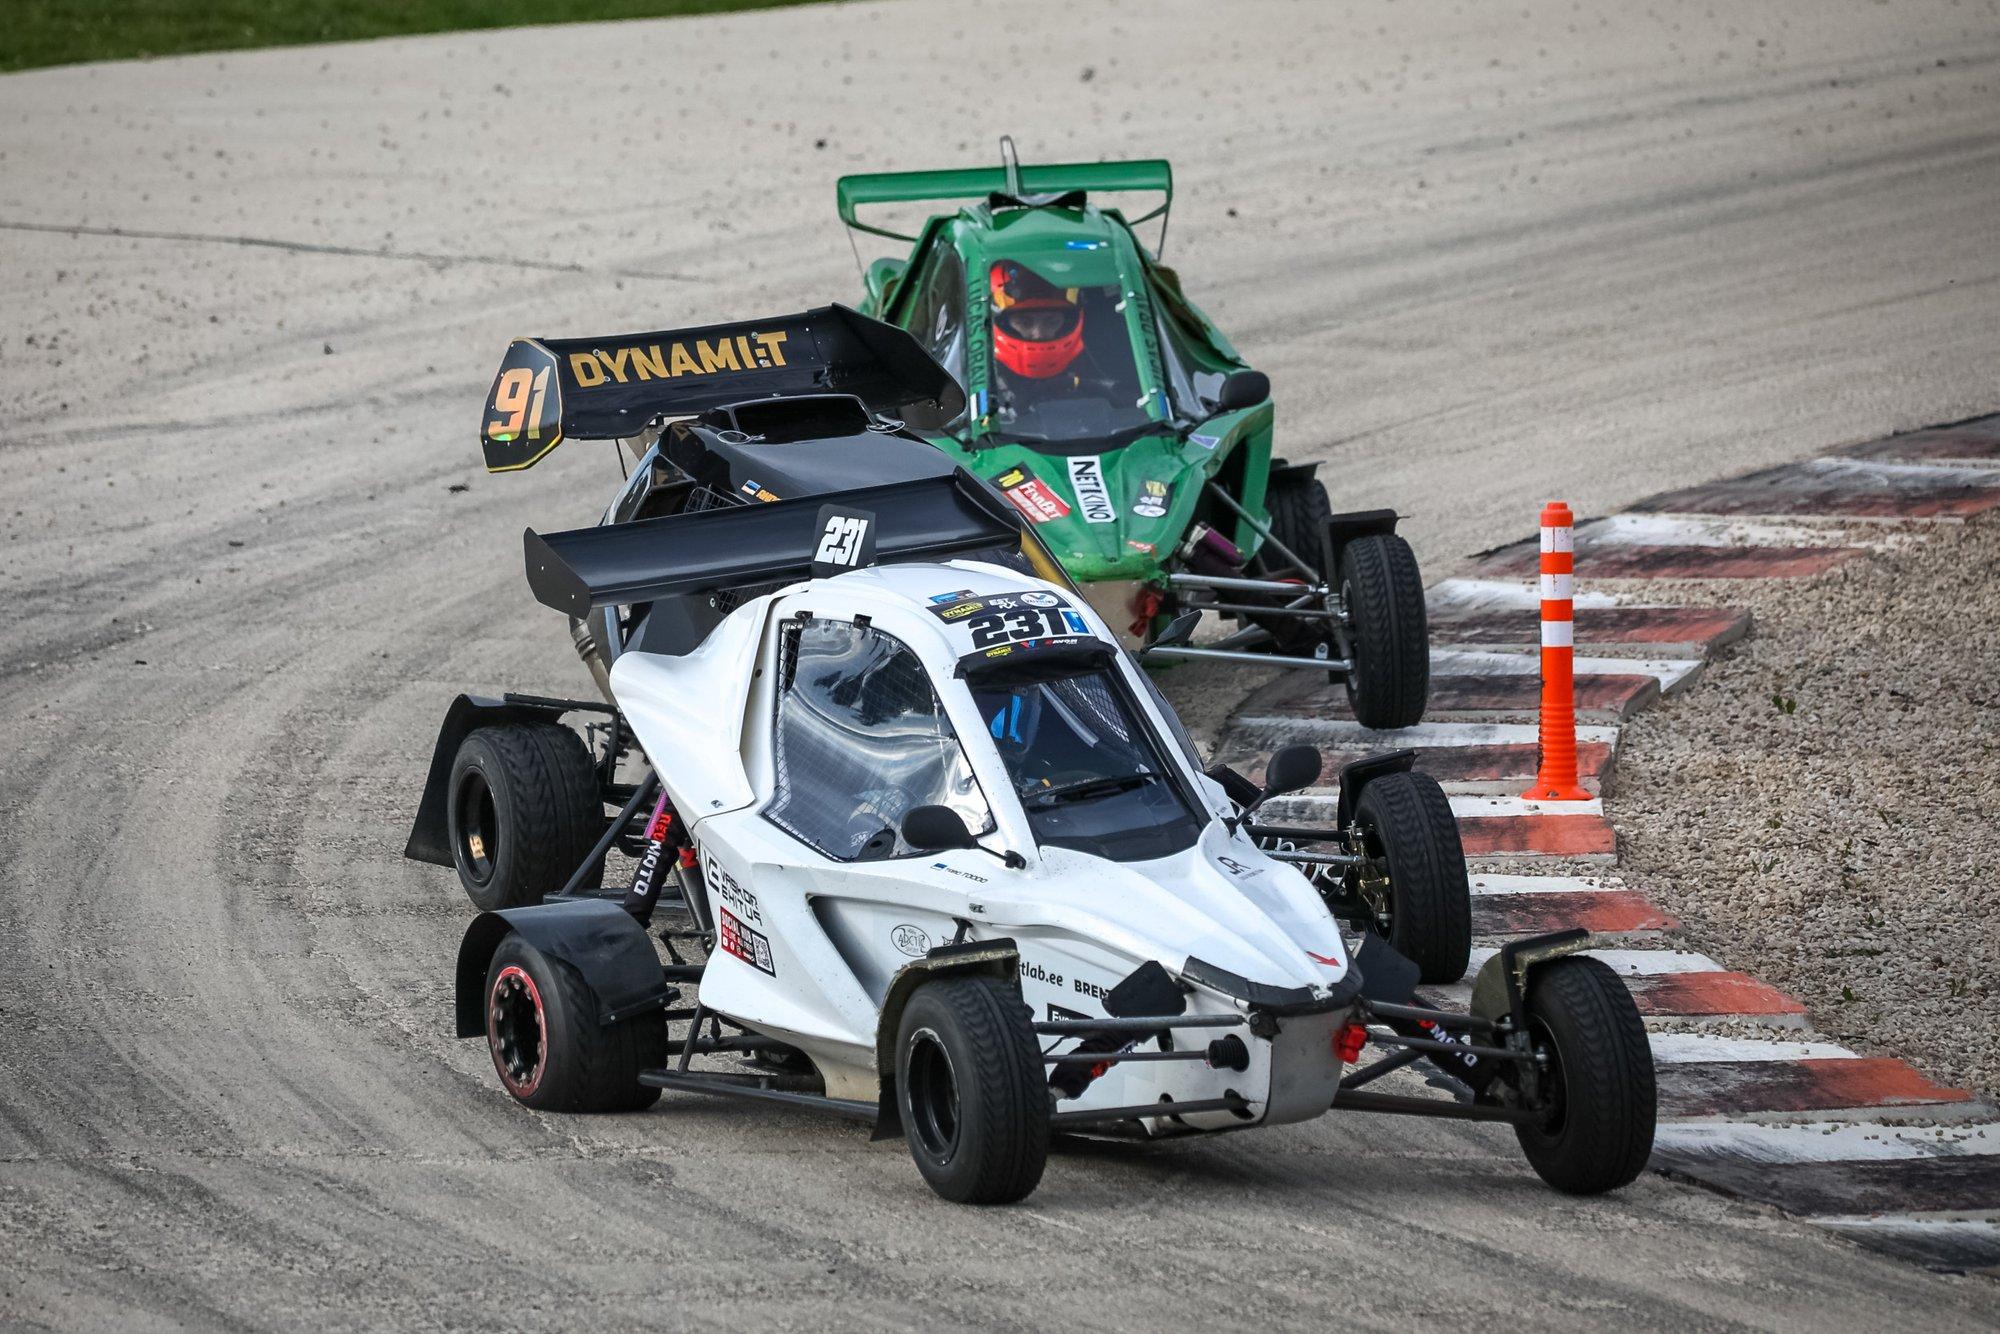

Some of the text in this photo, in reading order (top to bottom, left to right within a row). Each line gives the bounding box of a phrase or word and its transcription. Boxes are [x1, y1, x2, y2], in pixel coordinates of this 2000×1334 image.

[488, 366, 551, 441] 91
[814, 515, 868, 567] 231
[968, 609, 1068, 649] 231
[1018, 961, 1064, 987] tlab.ee
